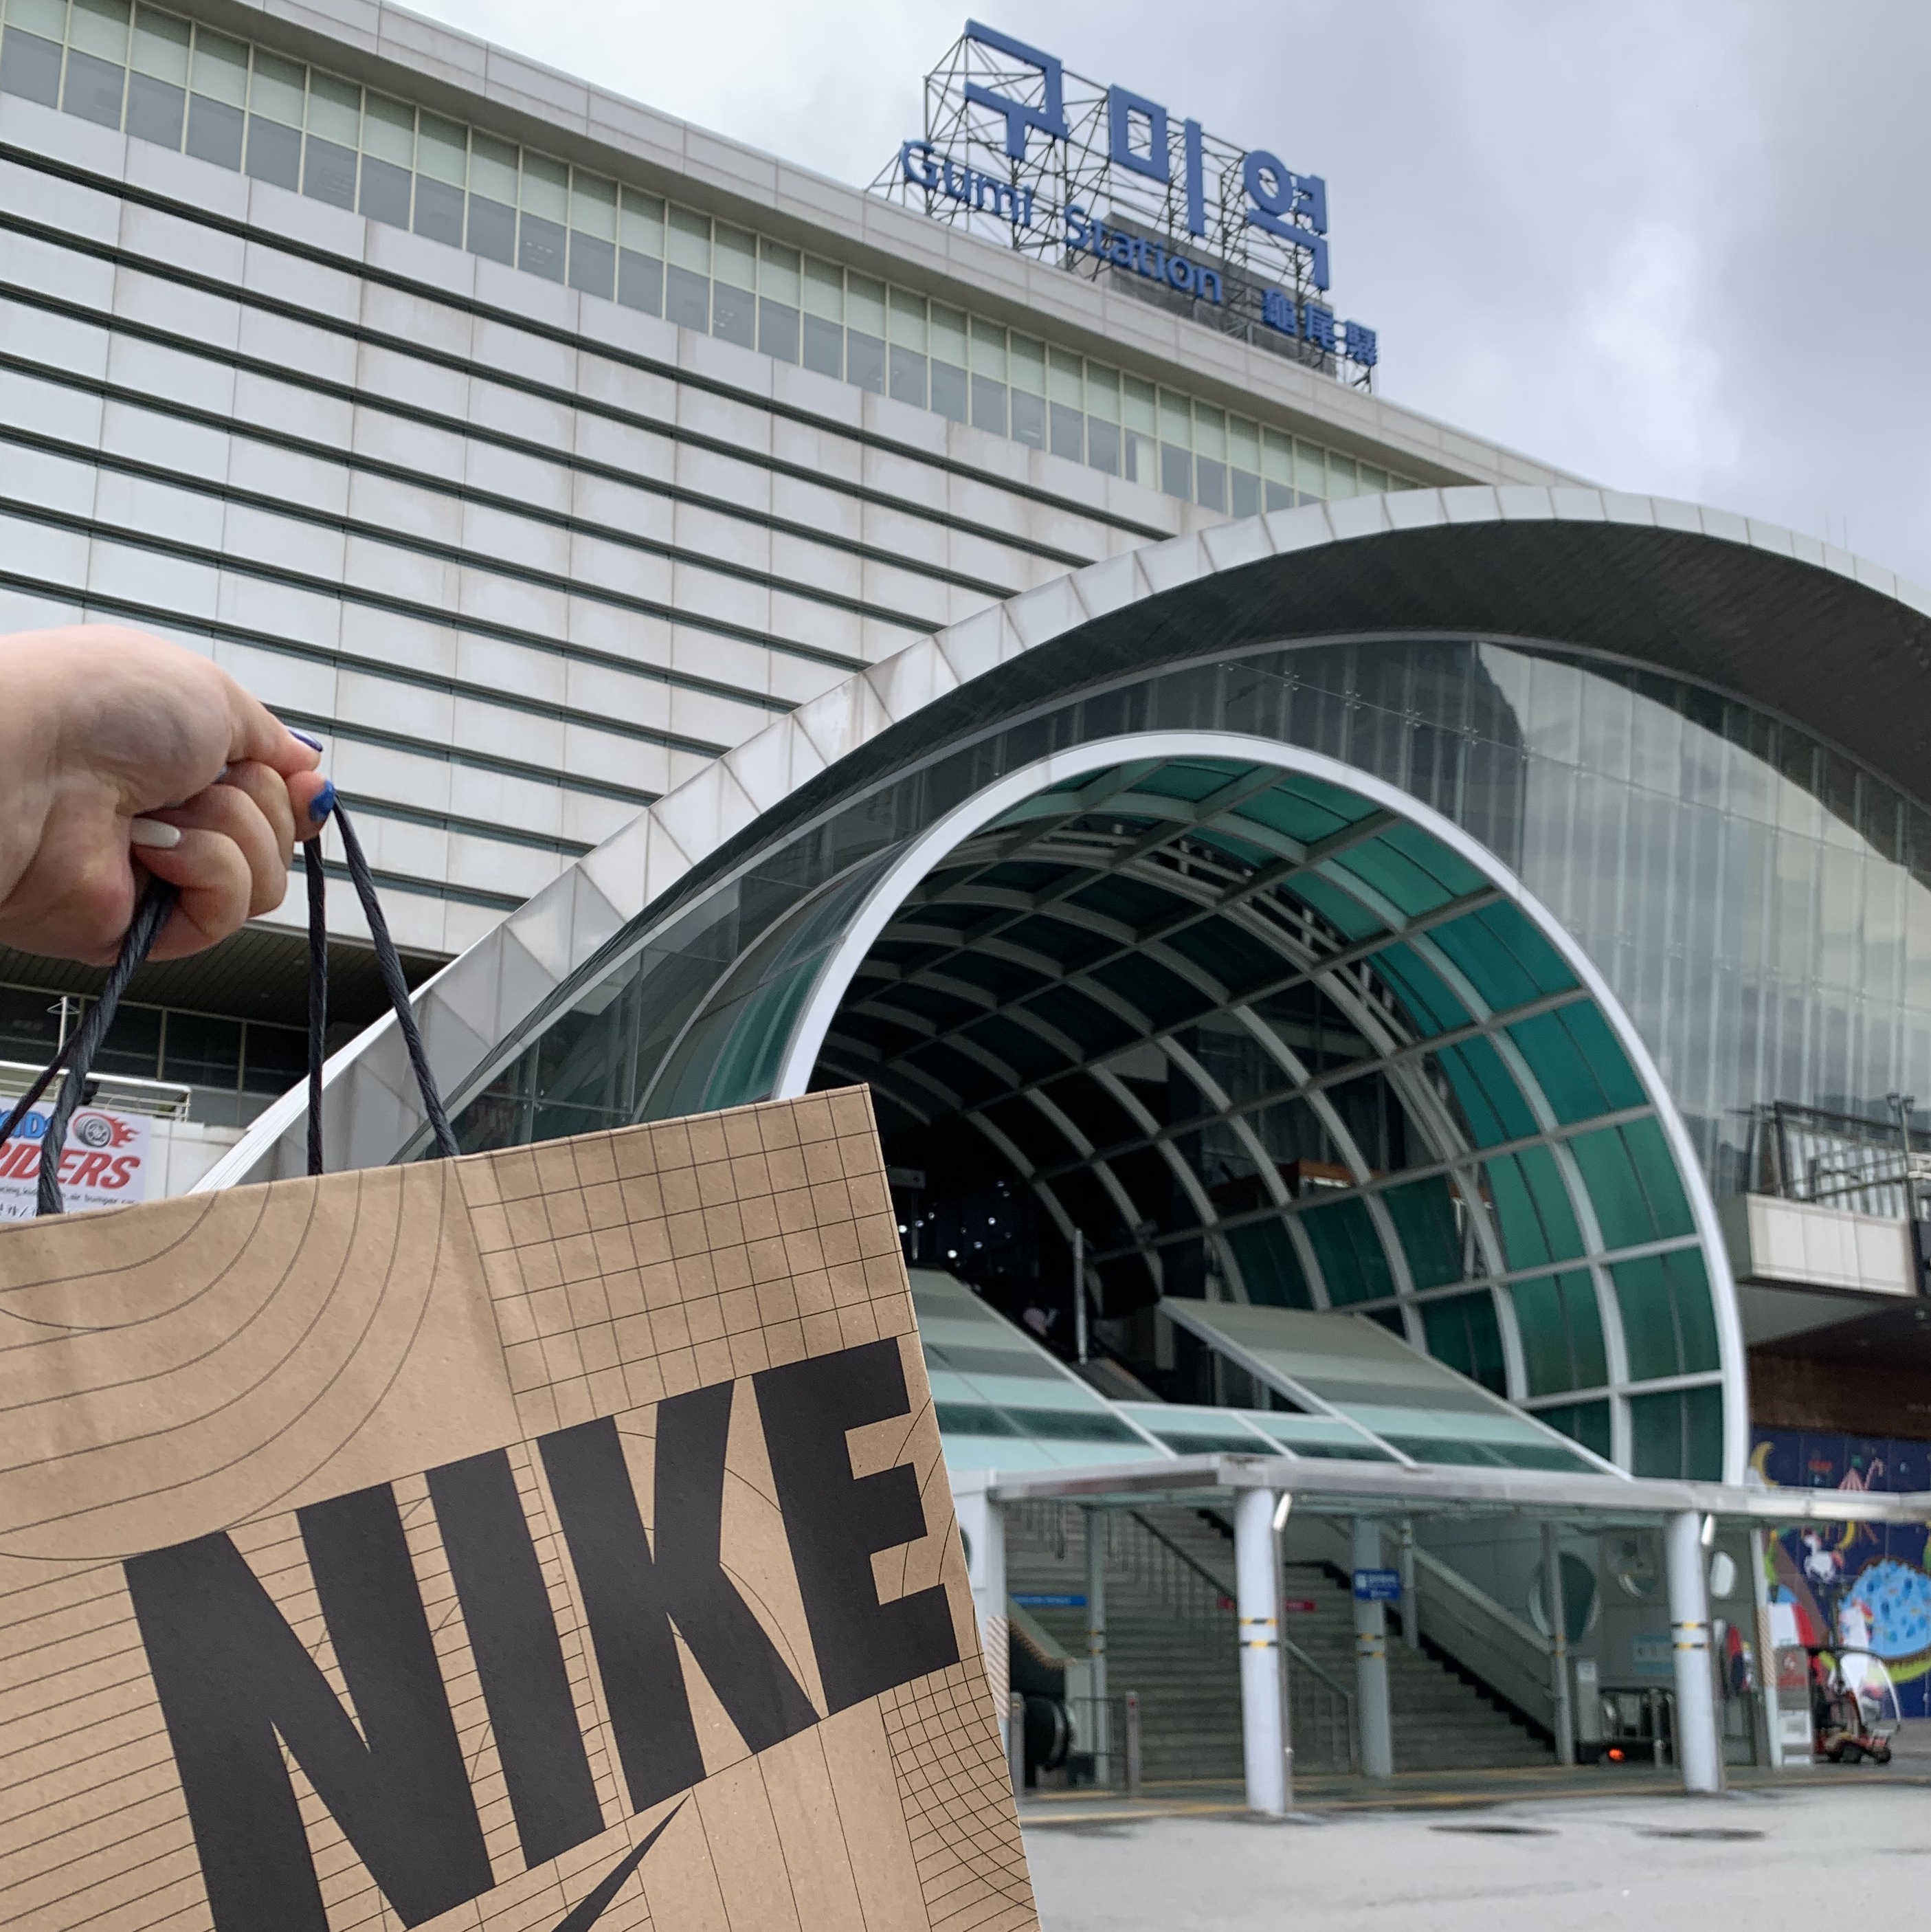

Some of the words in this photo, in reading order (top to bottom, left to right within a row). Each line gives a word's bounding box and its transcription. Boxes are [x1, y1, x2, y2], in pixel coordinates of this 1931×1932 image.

[900, 140, 1031, 227] Gumi
[1064, 204, 1223, 304] Station
[964, 18, 1330, 290] 구미역
[121, 1336, 961, 1932] NIKE
